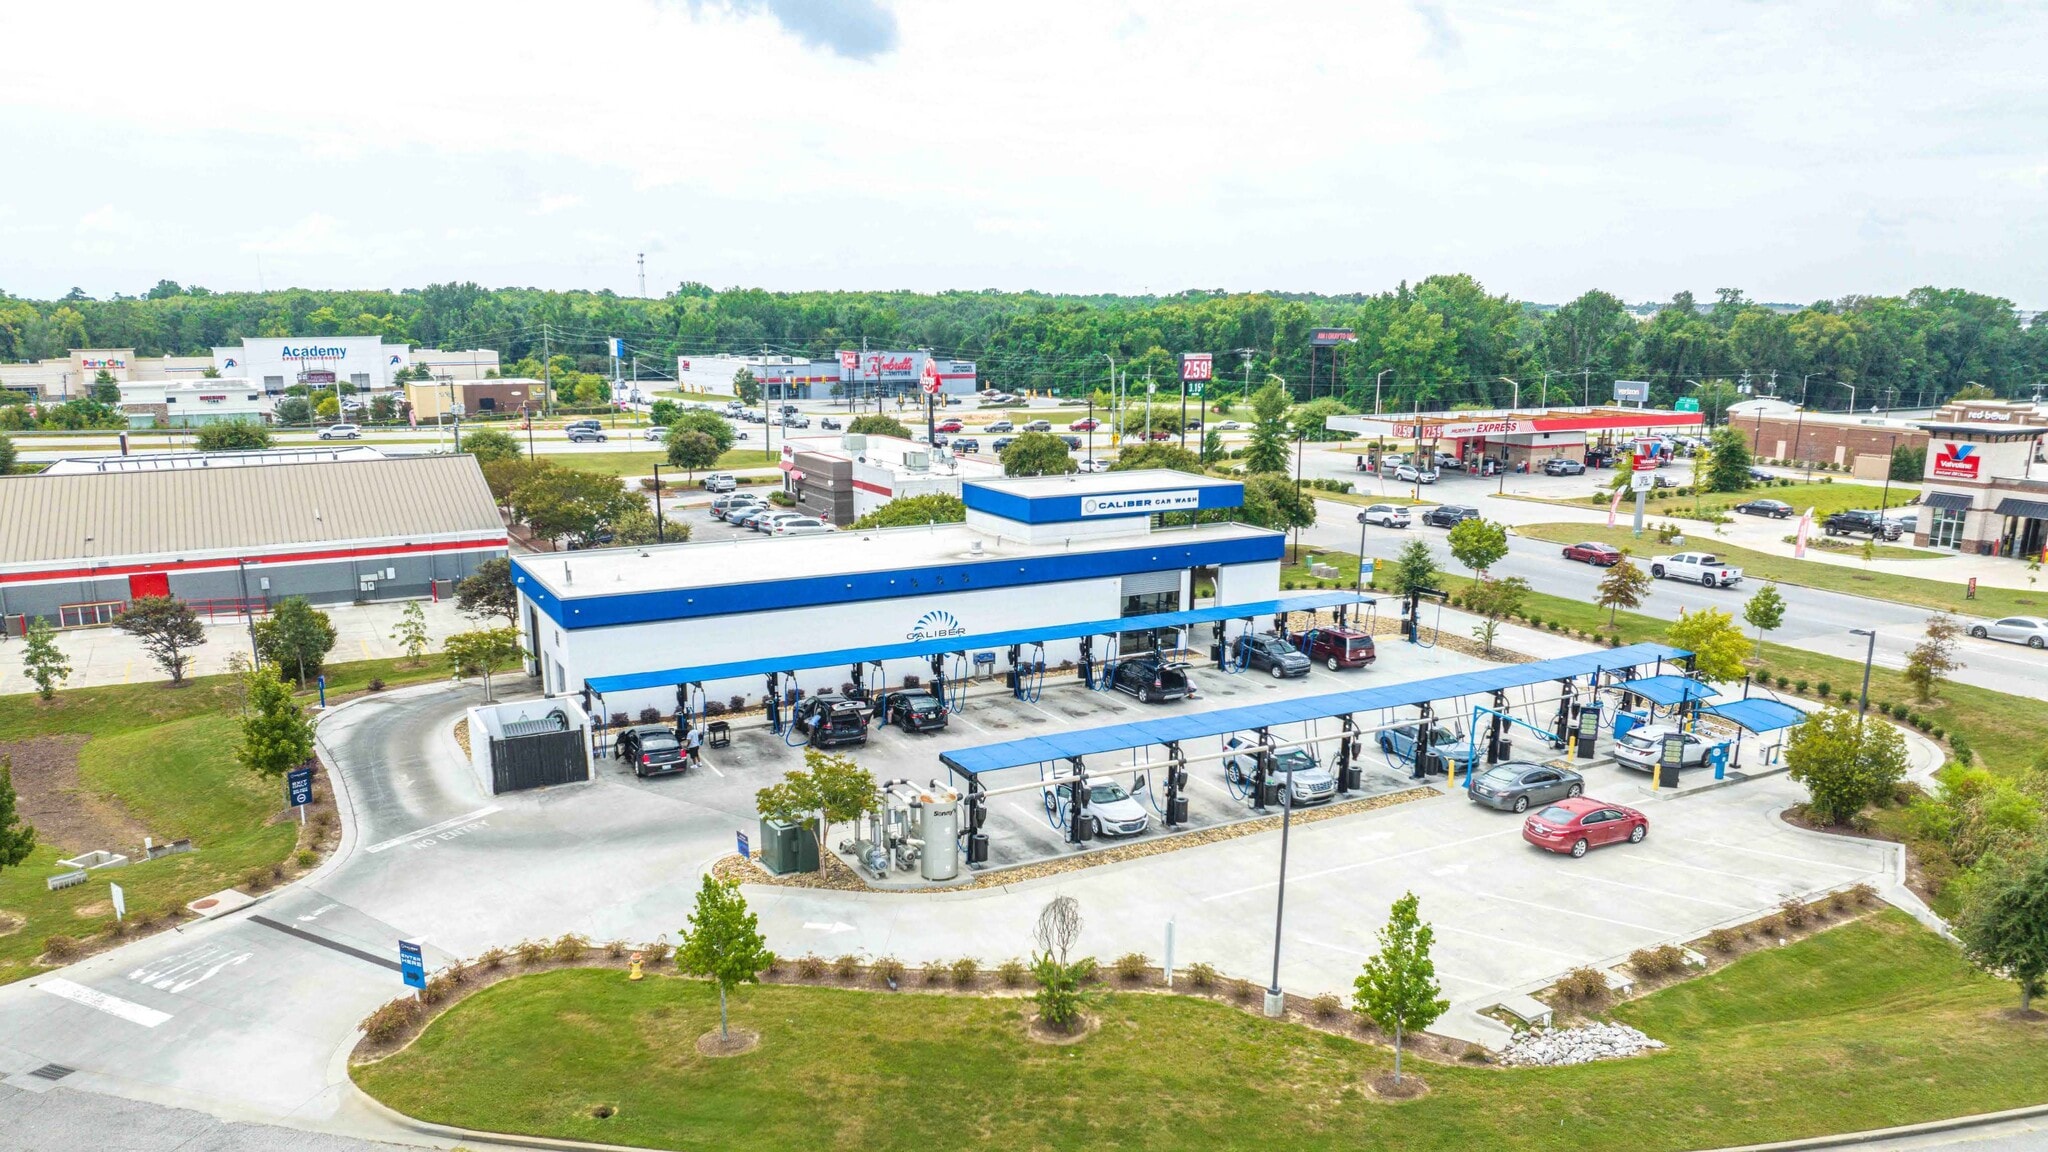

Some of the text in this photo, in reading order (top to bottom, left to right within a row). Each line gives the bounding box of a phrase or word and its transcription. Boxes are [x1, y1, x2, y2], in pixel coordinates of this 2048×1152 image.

[282, 345, 347, 359] Academy
[1476, 423, 1517, 433] EXPRESS
[1941, 460, 1973, 470] Valvoline
[1098, 500, 1152, 509] CALIBER
[906, 628, 966, 640] CALIBER
[412, 820, 490, 849] NO ENTRY
